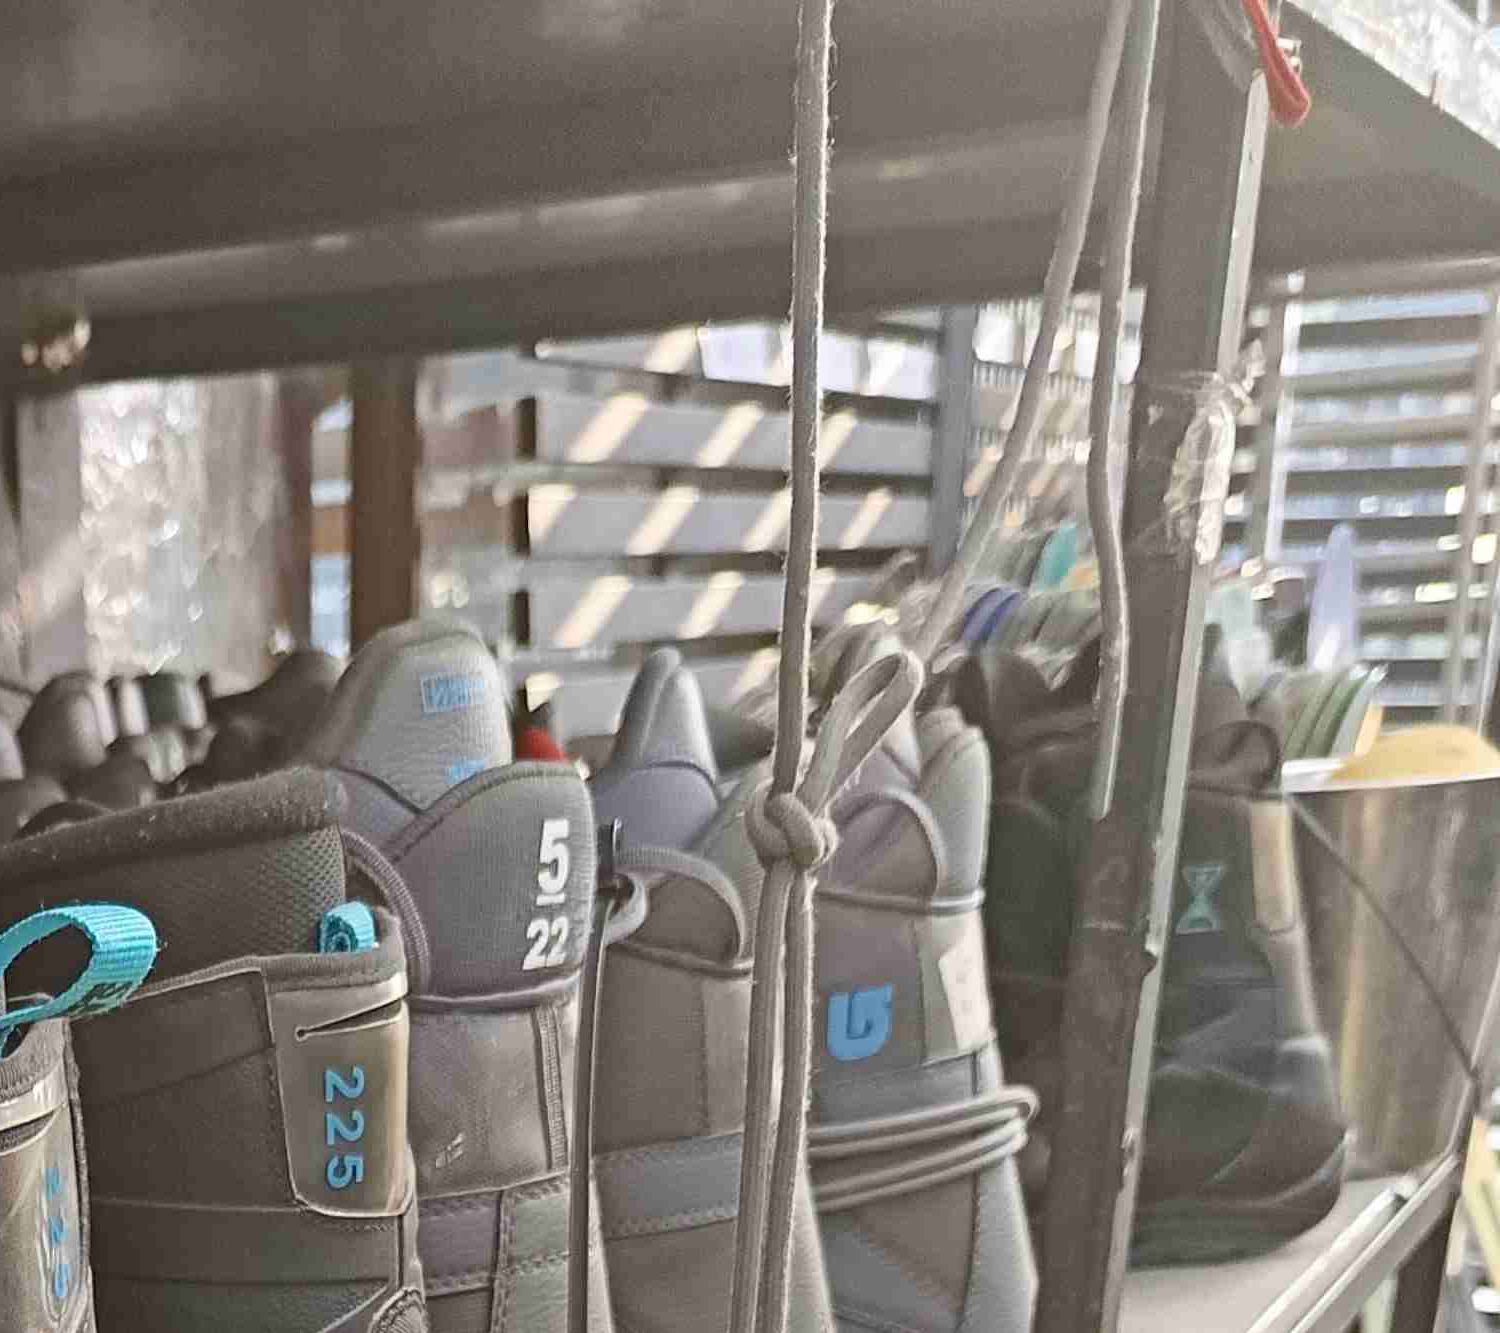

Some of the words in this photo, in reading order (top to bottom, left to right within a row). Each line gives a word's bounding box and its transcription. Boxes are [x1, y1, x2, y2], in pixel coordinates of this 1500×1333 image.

[537, 818, 570, 894] 5
[522, 915, 570, 971] 22
[324, 1064, 366, 1189] 225
